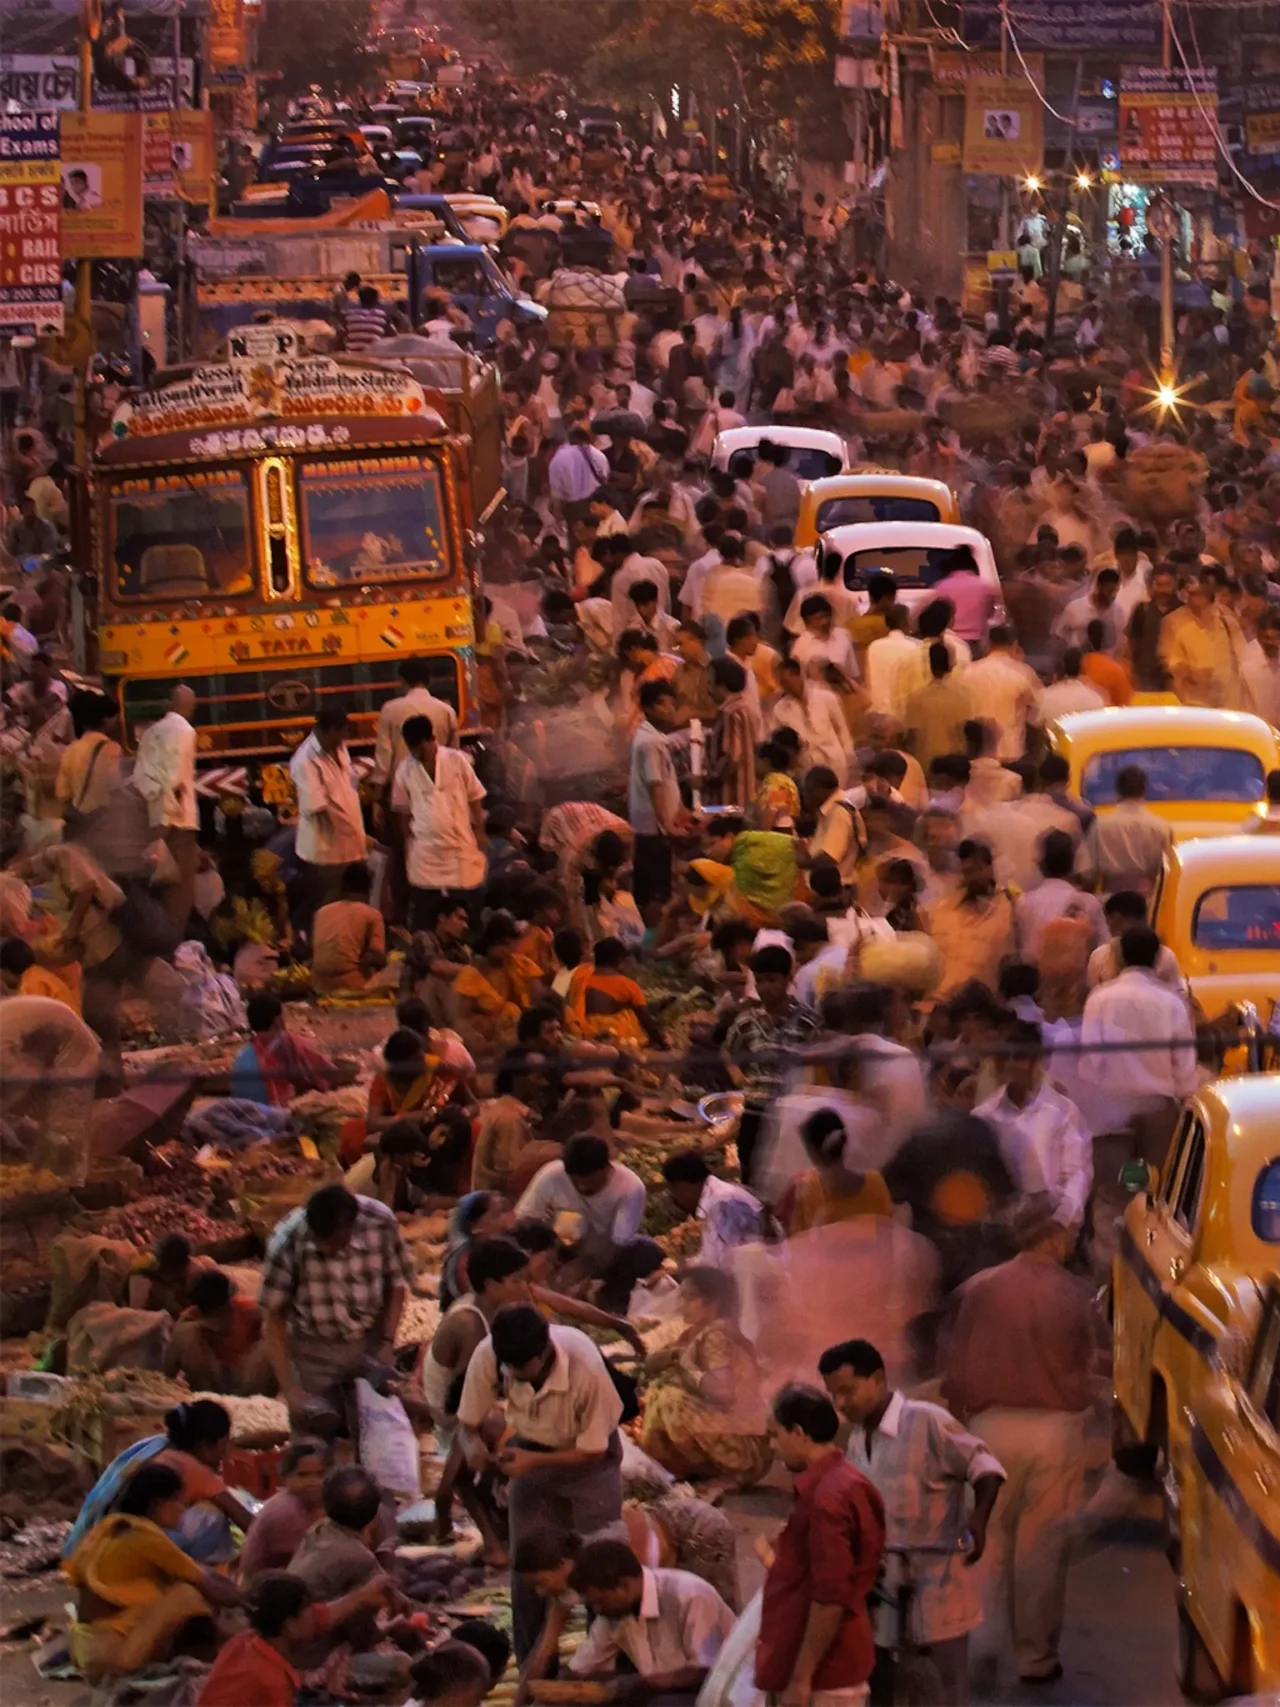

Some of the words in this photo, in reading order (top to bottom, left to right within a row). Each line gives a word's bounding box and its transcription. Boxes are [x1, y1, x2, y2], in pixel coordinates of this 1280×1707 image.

[0, 111, 36, 131] hool
[40, 112, 58, 131] of
[0, 135, 58, 156] Exams
[22, 238, 59, 258] RAIL
[20, 264, 60, 284] CDS
[276, 333, 293, 354] P
[259, 638, 312, 653] TATA
